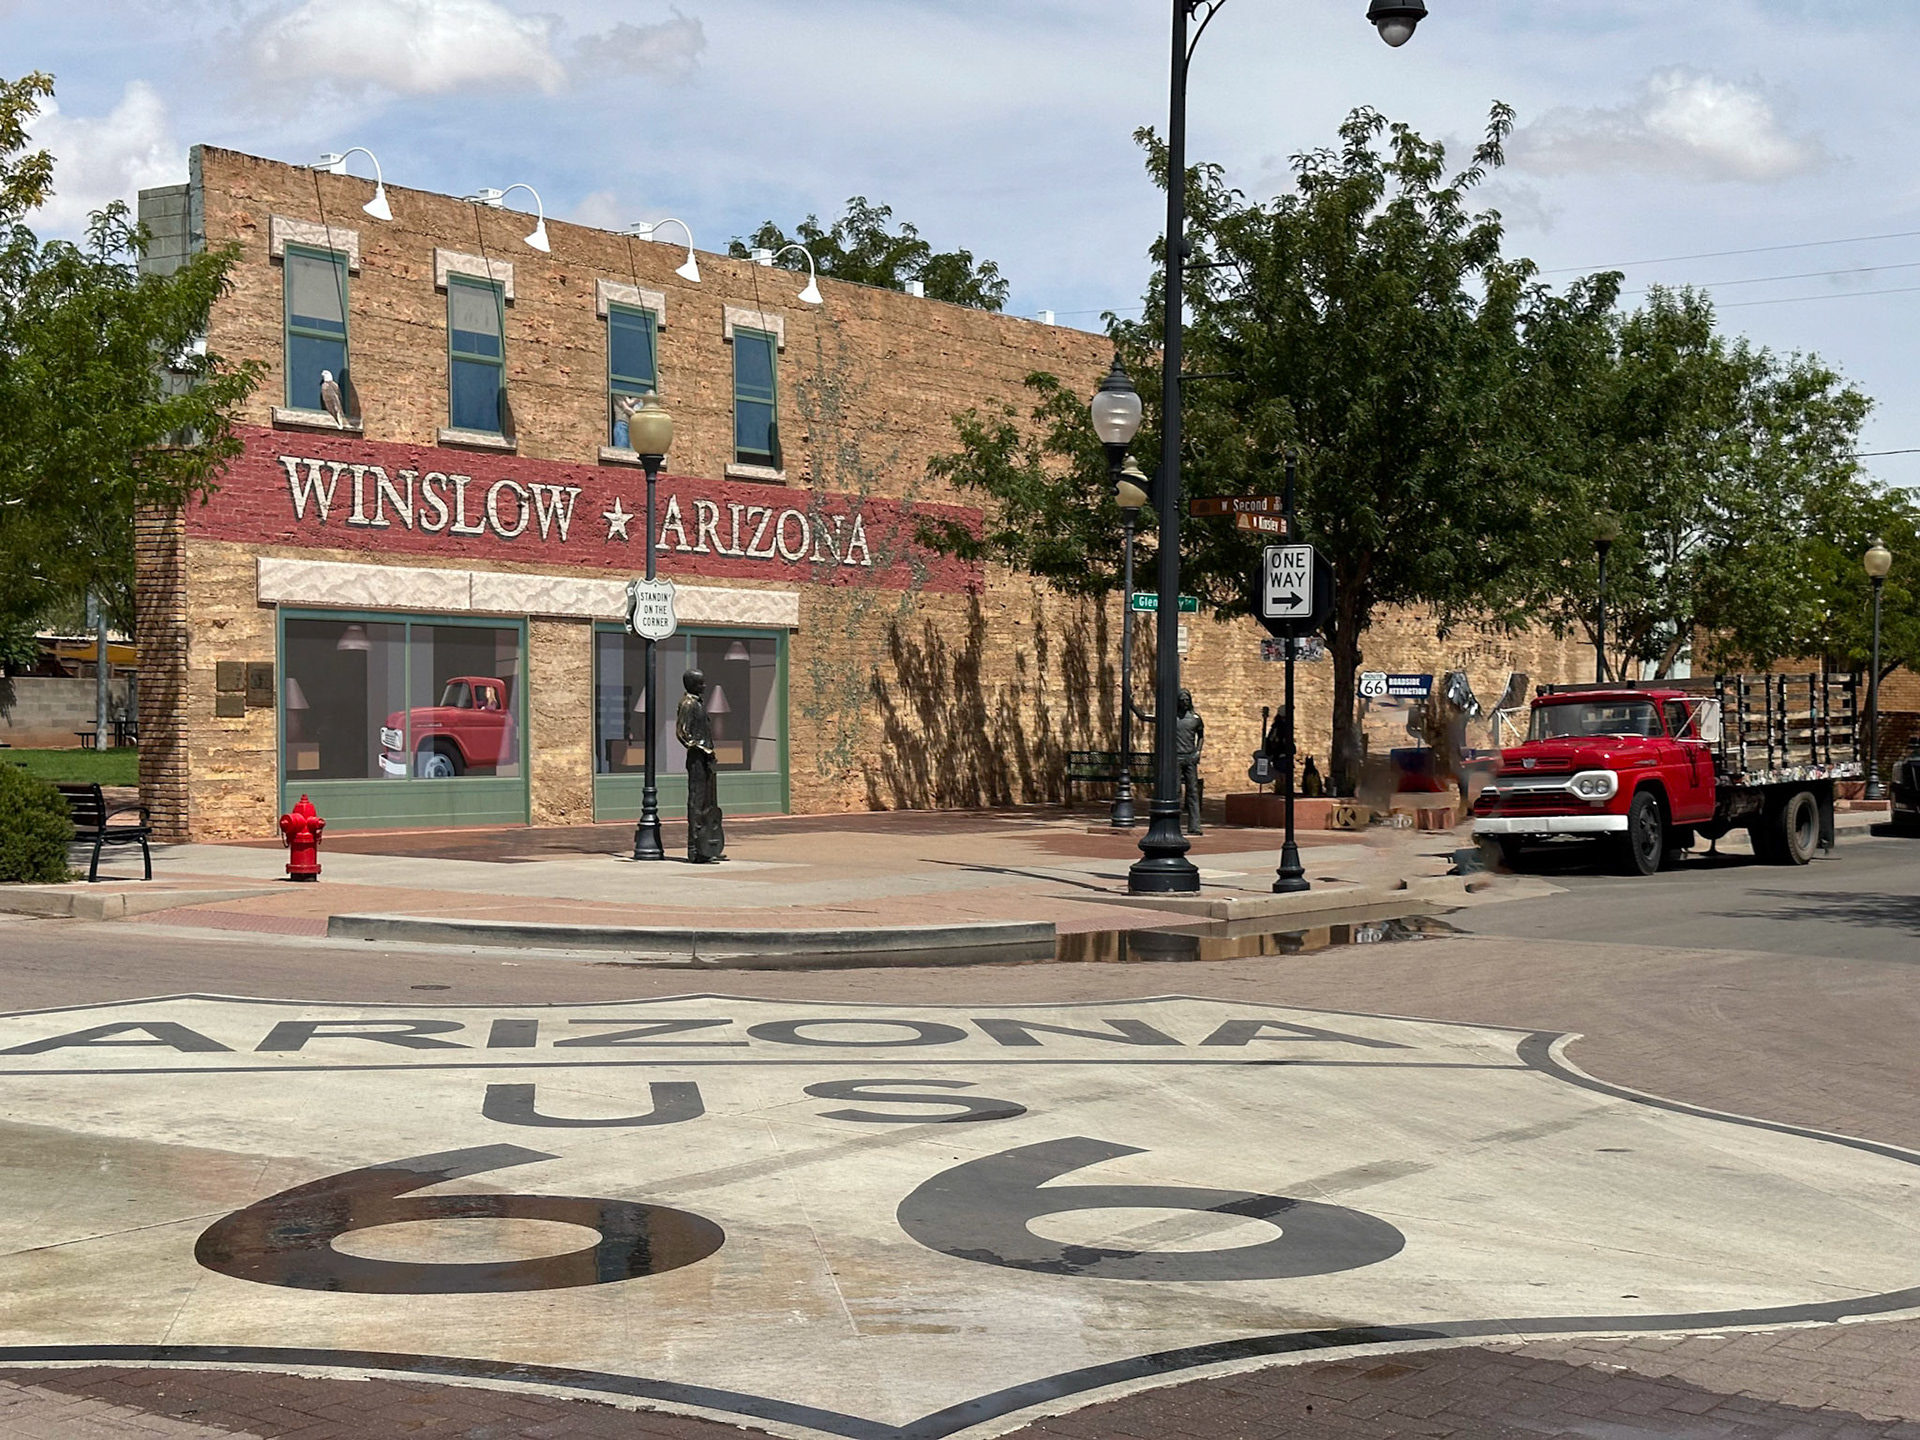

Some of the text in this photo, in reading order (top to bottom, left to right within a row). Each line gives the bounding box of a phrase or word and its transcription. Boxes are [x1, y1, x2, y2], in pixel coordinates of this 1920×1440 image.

[279, 455, 872, 567] WINSLOW ARIZONA
[1233, 498, 1268, 511] Second
[1271, 552, 1305, 569] ONE
[1270, 571, 1306, 588] WAY
[640, 592, 671, 602] STANDIN'
[644, 604, 667, 615] ON THE
[642, 617, 669, 627] CORNER
[1364, 680, 1383, 695] 66
[1388, 677, 1421, 686] ROADSIDE
[0, 1017, 1417, 1055] ARIZONA
[193, 1135, 1407, 1294] 66
